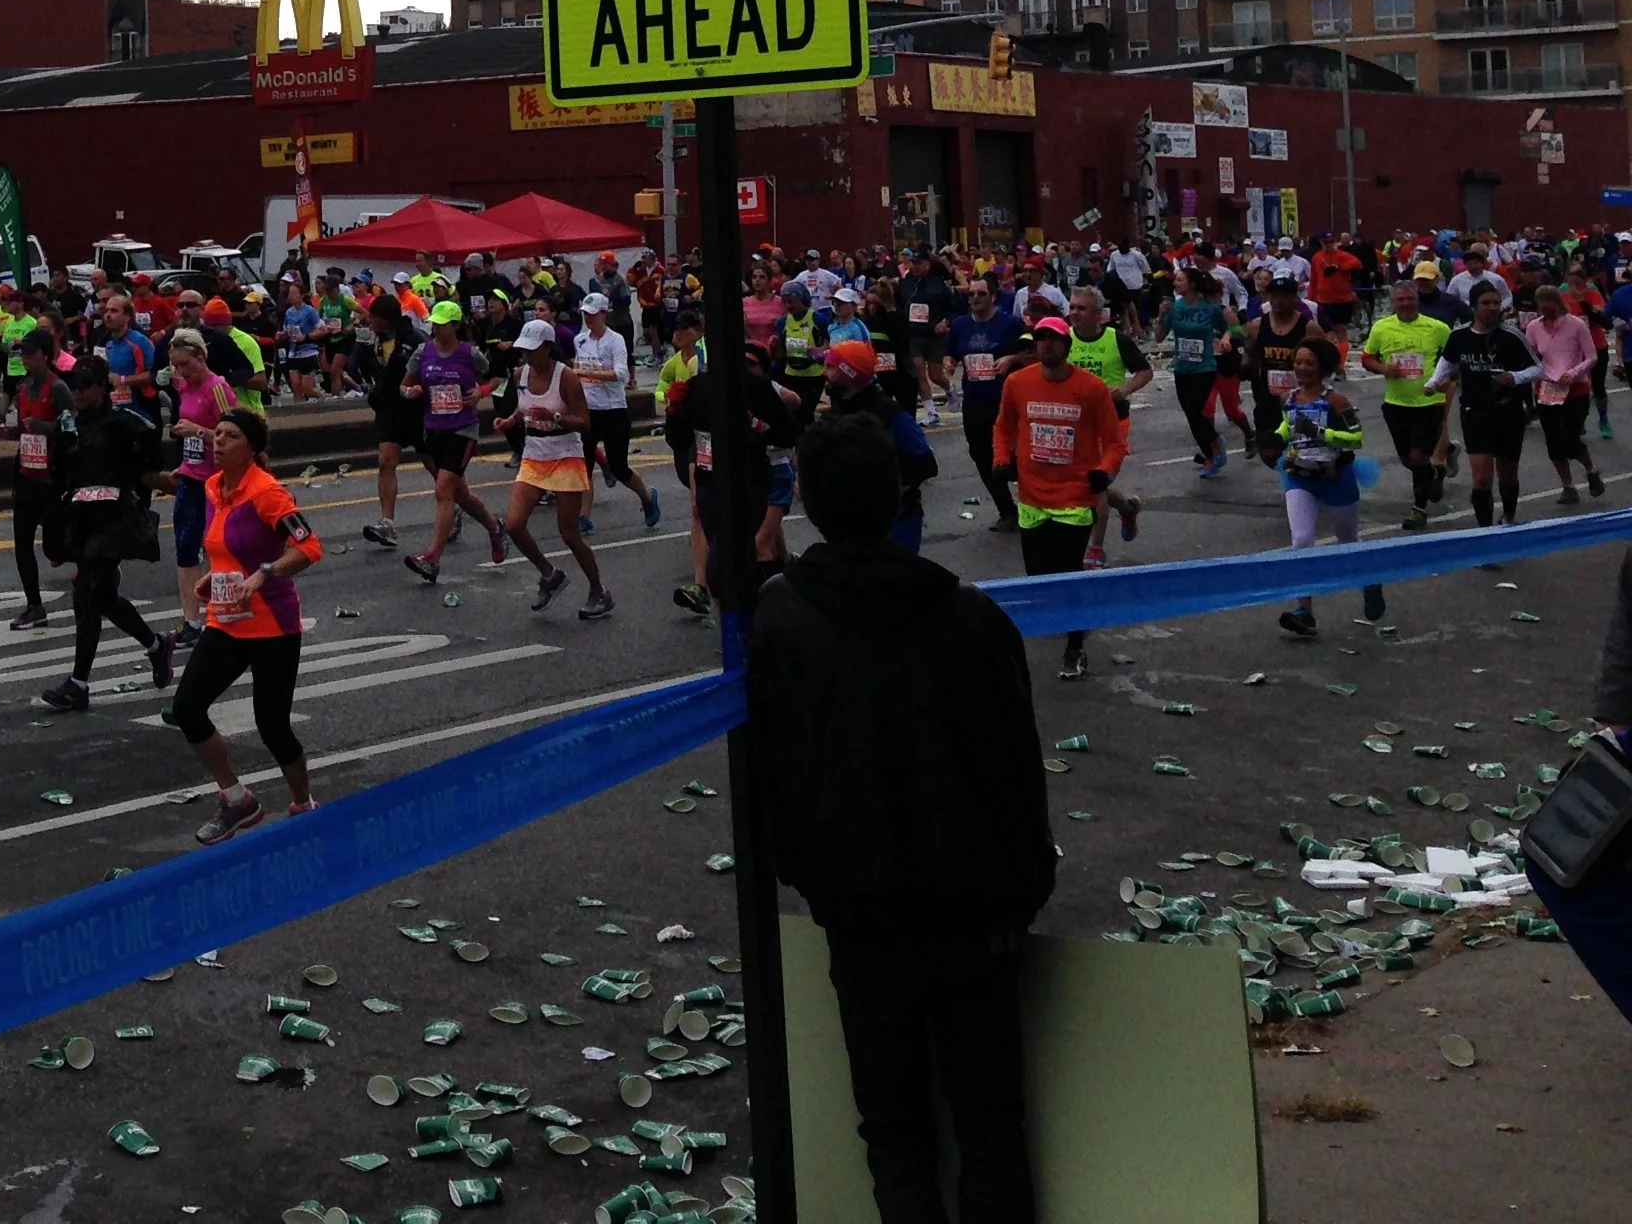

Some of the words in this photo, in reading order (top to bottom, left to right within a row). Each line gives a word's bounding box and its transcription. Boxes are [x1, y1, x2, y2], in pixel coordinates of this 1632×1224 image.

[255, 65, 357, 89] McDonald's
[271, 86, 338, 100] Restaurant
[20, 914, 105, 996] POLICE
[109, 897, 165, 958] LINE
[178, 883, 211, 938] DO
[213, 862, 255, 924] NOT
[264, 837, 329, 908] CROSS
